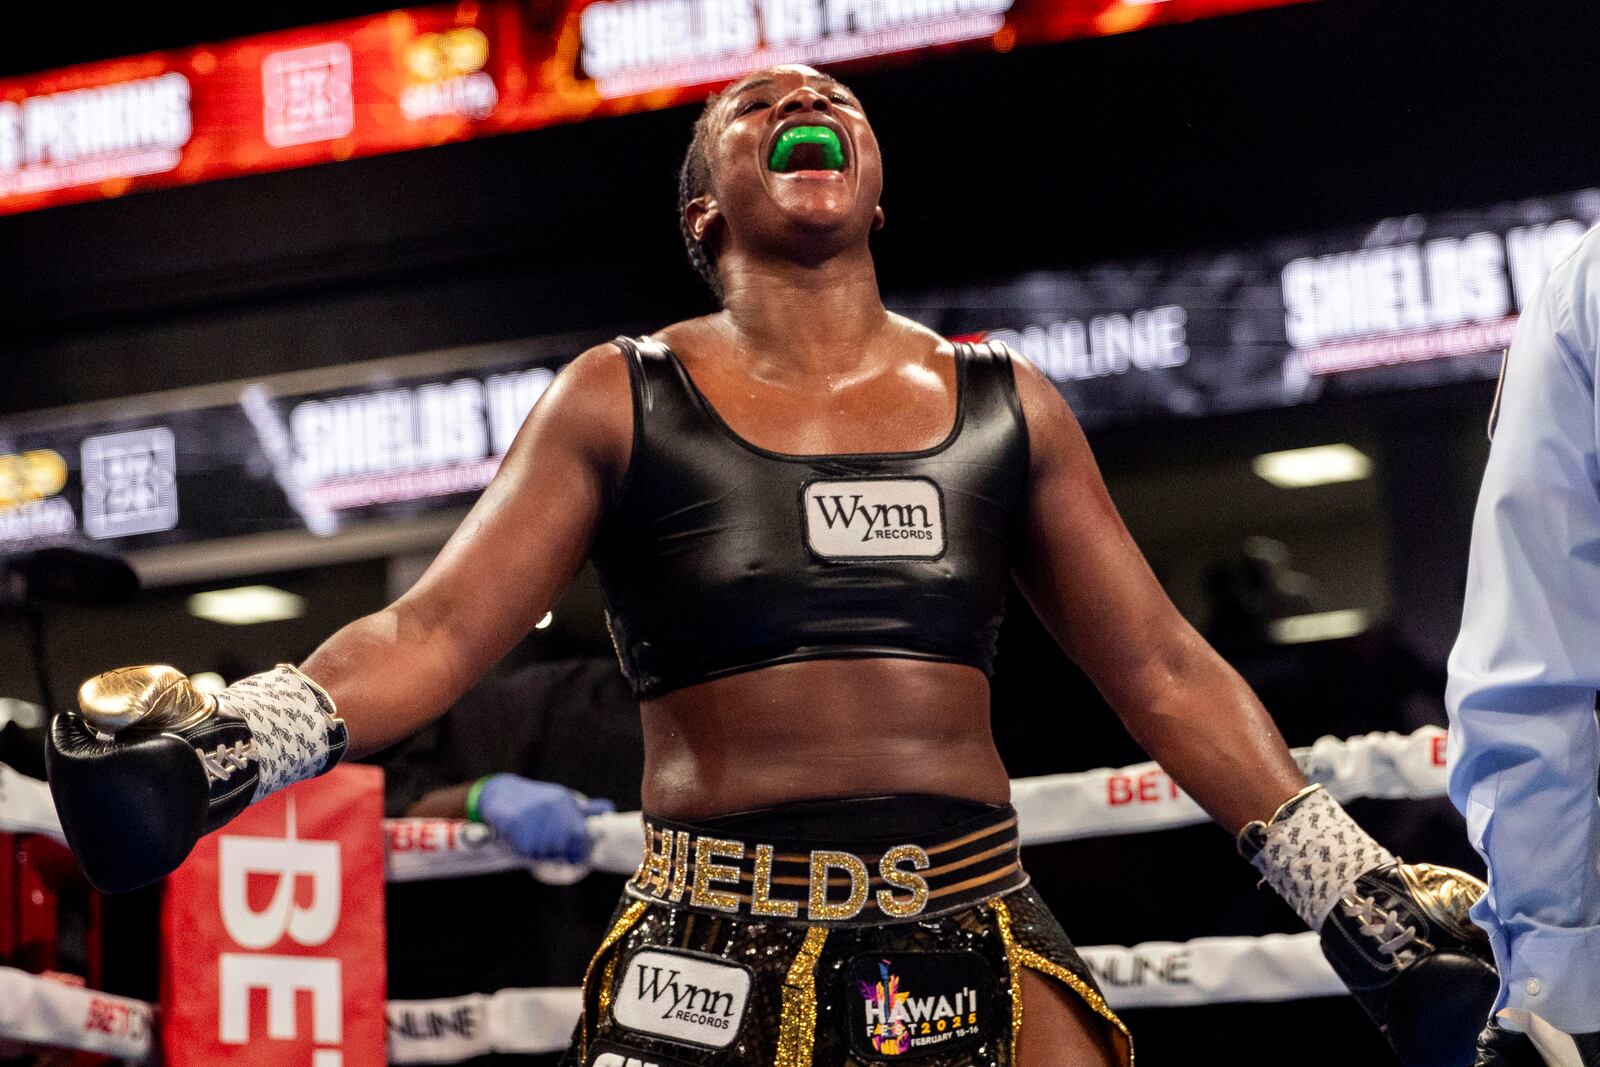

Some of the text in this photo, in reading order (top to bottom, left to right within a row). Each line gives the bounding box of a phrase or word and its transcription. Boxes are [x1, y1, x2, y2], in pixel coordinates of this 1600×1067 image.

[812, 494, 934, 542] Wynn
[875, 529, 933, 540] RECORDS
[218, 834, 344, 1067] BE
[637, 964, 735, 1019] Wynn
[675, 1010, 730, 1030] RECORDS
[866, 1013, 977, 1038] FEST 2025
[910, 1031, 953, 1047] FEBRUARY
